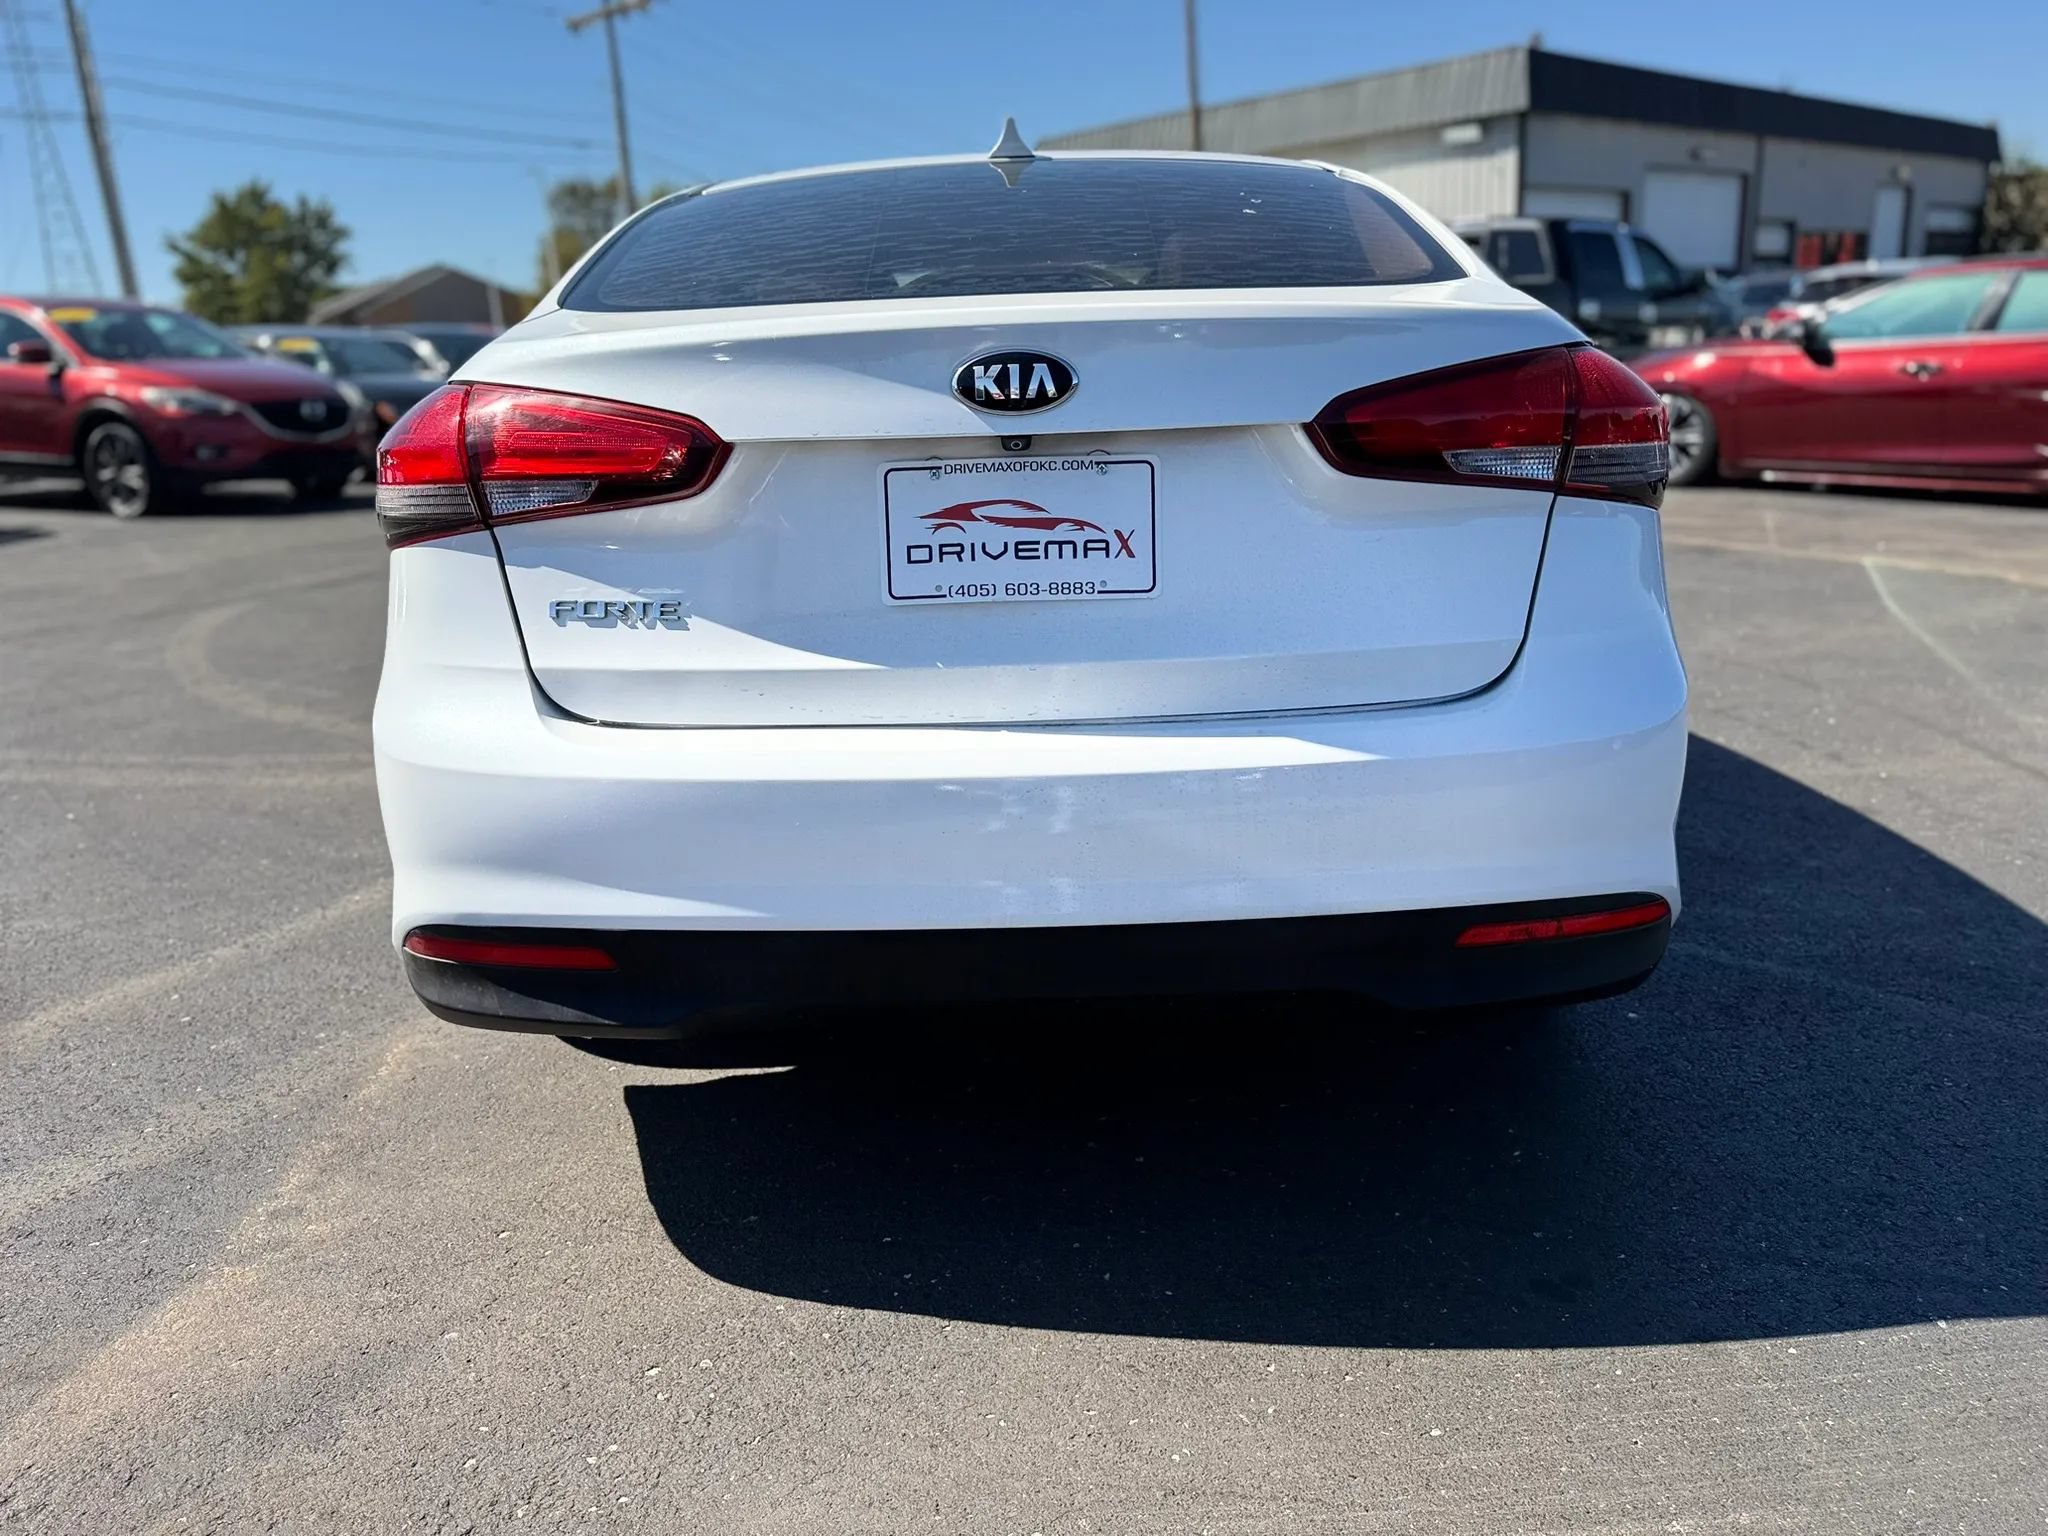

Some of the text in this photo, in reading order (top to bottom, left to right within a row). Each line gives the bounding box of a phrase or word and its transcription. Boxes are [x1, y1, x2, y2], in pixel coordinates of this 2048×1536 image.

[972, 363, 1058, 401] KIA
[943, 460, 1094, 475] DRIVEMAXOFOKC.COM
[906, 529, 1136, 564] DRIVEMAX
[948, 581, 1096, 598] (405) 603-8883
[549, 599, 682, 621] FORTE
